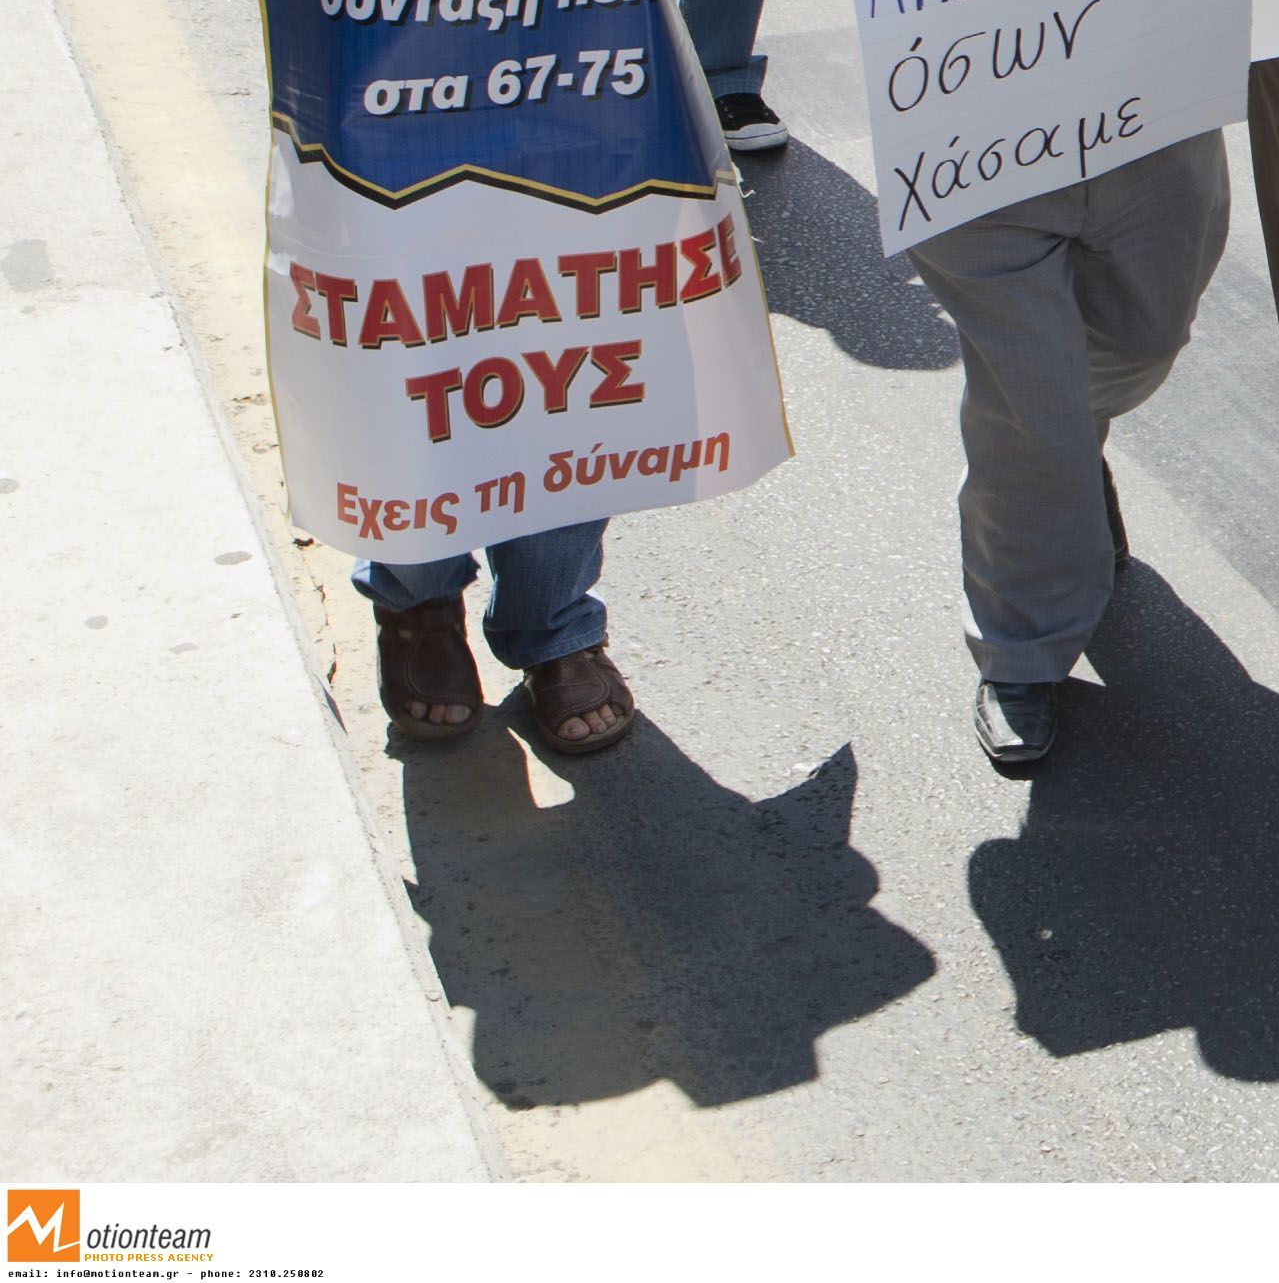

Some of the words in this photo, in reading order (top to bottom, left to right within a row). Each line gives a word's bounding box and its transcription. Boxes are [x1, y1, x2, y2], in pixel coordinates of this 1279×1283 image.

[363, 72, 468, 118] στα
[486, 47, 648, 107] 67-75
[289, 211, 742, 349] ΣΤΑΜΑΤΗΣΕ
[405, 338, 647, 444] ΤΟΥΣ
[336, 482, 461, 541] Εχεις
[474, 467, 528, 514] τη
[542, 430, 733, 495] δύναμη
